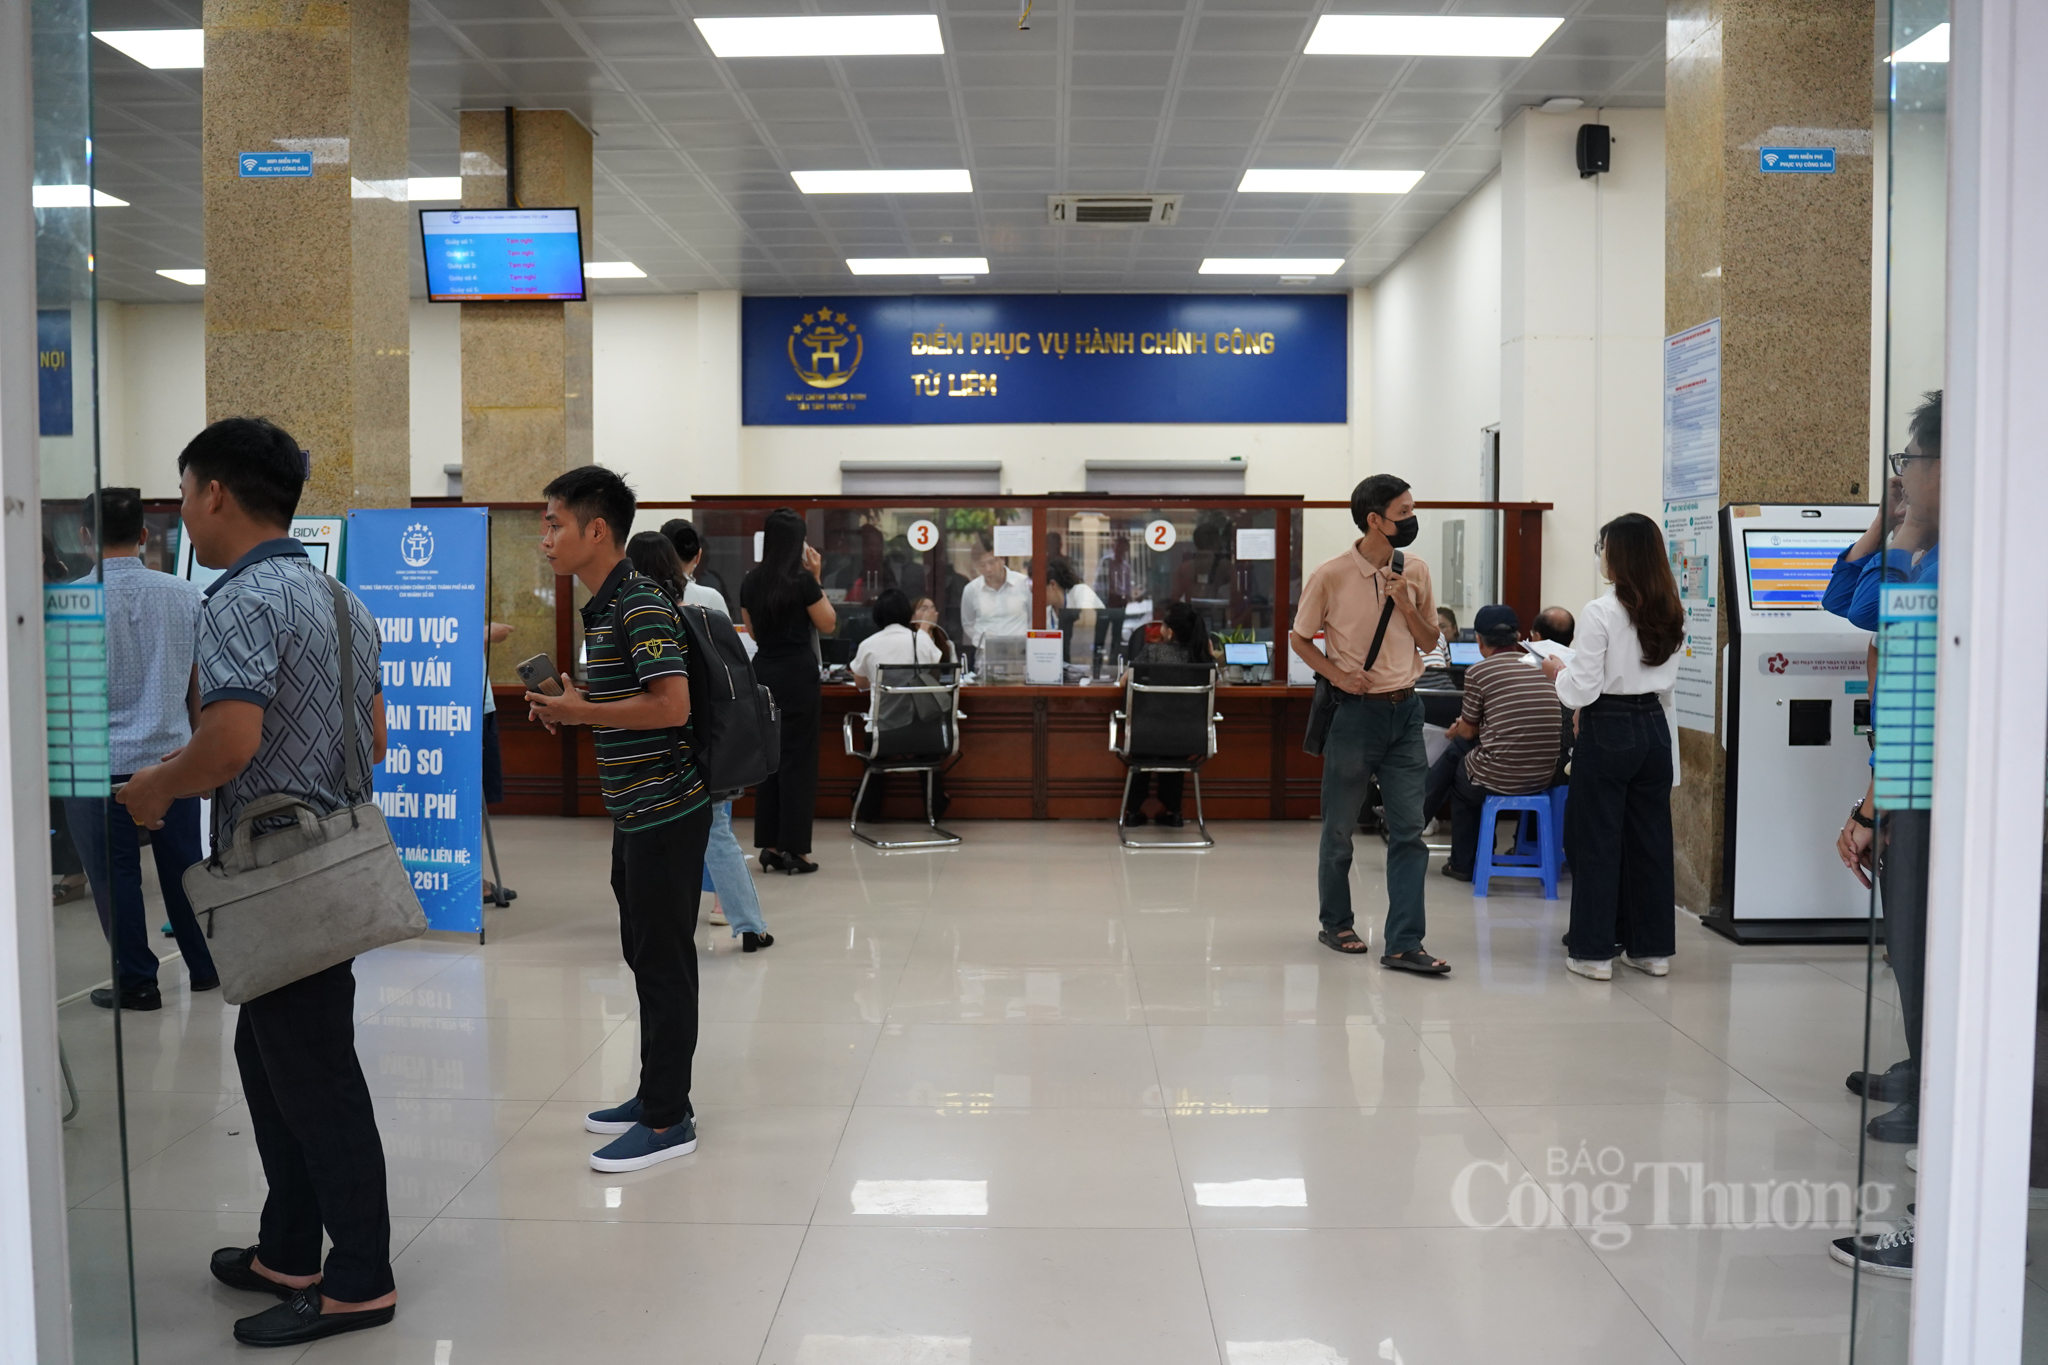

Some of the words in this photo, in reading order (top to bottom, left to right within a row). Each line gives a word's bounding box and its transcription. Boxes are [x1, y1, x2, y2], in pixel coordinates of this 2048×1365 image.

[912, 323, 963, 355] ĐIỂM
[971, 332, 1030, 360] PHỤC
[1038, 332, 1069, 360] VỤ
[1076, 328, 1134, 354] HÀNH
[1141, 328, 1207, 355] CHÍNH
[1215, 328, 1275, 355] CÔNG
[912, 369, 941, 396] TỪ
[949, 370, 997, 396] LIÊM
[293, 528, 319, 537] BIDV
[917, 526, 929, 545] 3
[1154, 526, 1166, 545] 2
[47, 594, 90, 610] AUTO
[1893, 595, 1938, 610] AUTO
[375, 618, 413, 643] KHU
[419, 616, 458, 648] VỰC
[381, 659, 405, 686] TƯ
[411, 656, 451, 687] VẤN
[386, 700, 410, 730] ÀN
[416, 701, 471, 736] THIỆN
[385, 743, 411, 774] HỒ
[417, 748, 442, 775] SƠ
[373, 785, 419, 818] MIỄN
[425, 789, 457, 819] PHÍ
[405, 844, 428, 862] MẮC
[431, 847, 452, 863] LIÊN
[455, 848, 470, 866] HỆ:
[414, 871, 448, 890] 2611
